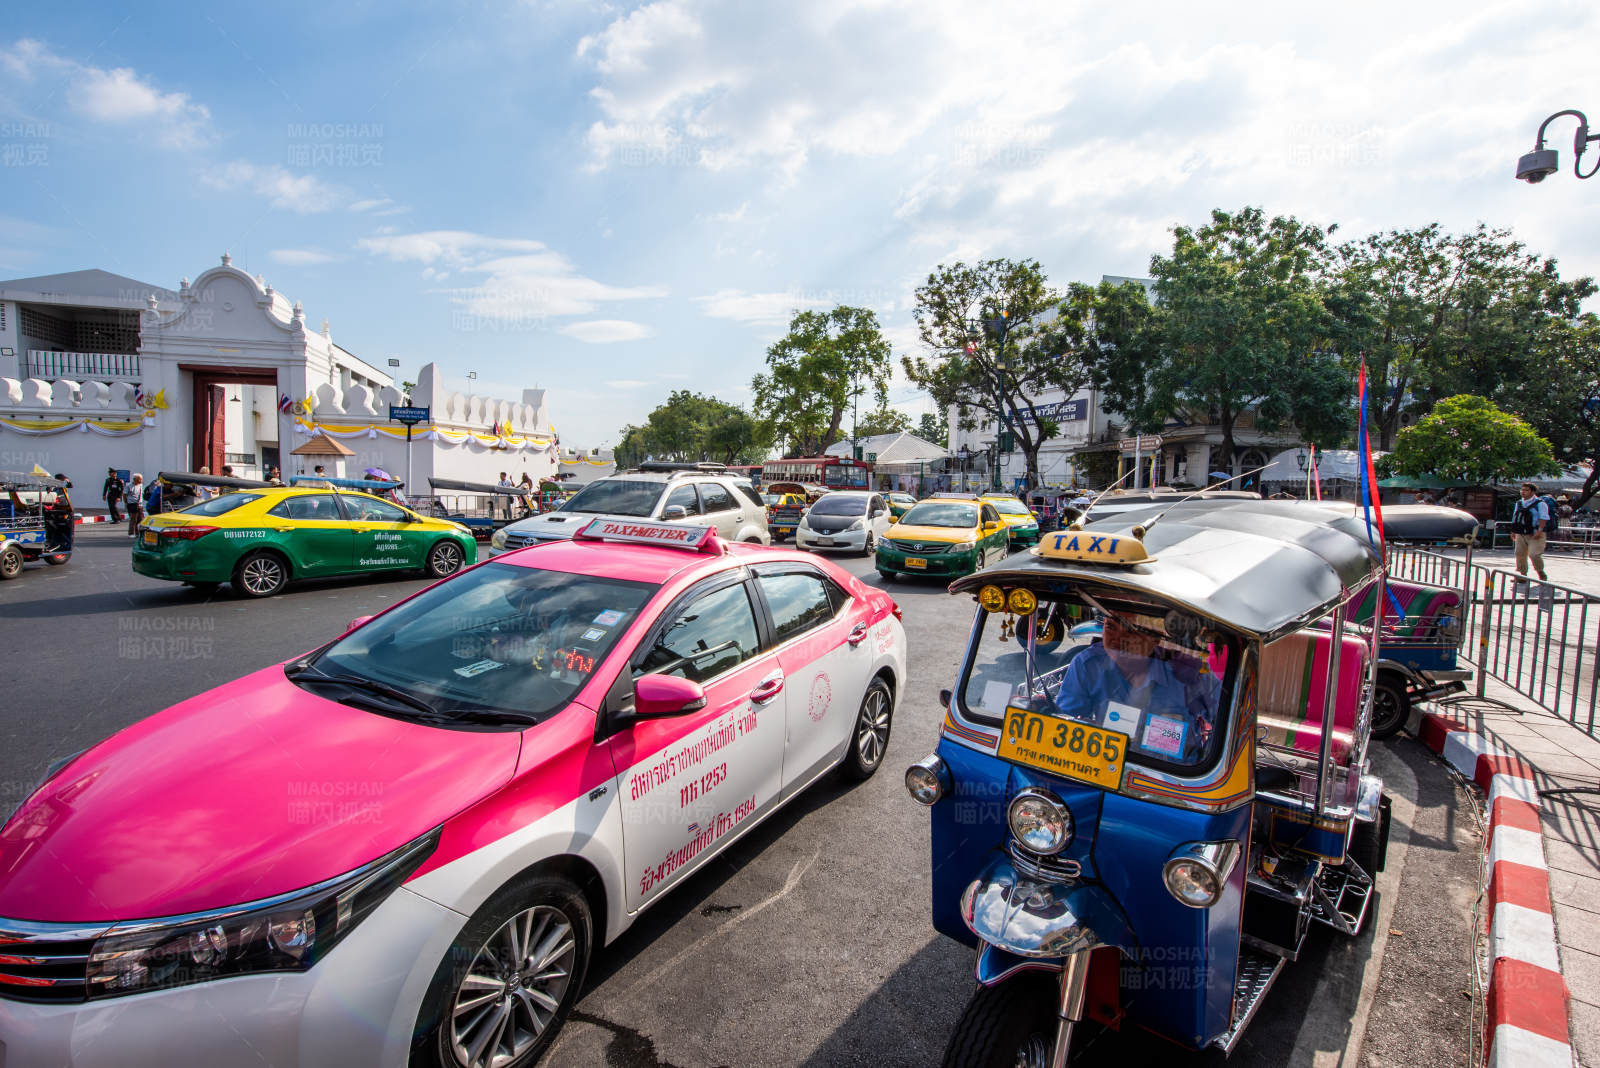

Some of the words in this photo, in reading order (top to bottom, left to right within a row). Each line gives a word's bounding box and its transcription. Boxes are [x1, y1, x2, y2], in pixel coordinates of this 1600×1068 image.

[602, 523, 689, 541] TAXI-METER
[1053, 534, 1121, 555] TAXI
[737, 706, 758, 737] จำกัด
[1009, 712, 1044, 743] สก
[1052, 723, 1121, 762] 3865
[1161, 728, 1181, 741] 2563
[1015, 746, 1101, 777] กรุงเทพมหานคร
[700, 762, 727, 796] 1253
[639, 816, 714, 896] ร้องเรียนแท็กซี่
[716, 812, 734, 839] โทร.
[734, 793, 756, 824] 1584
